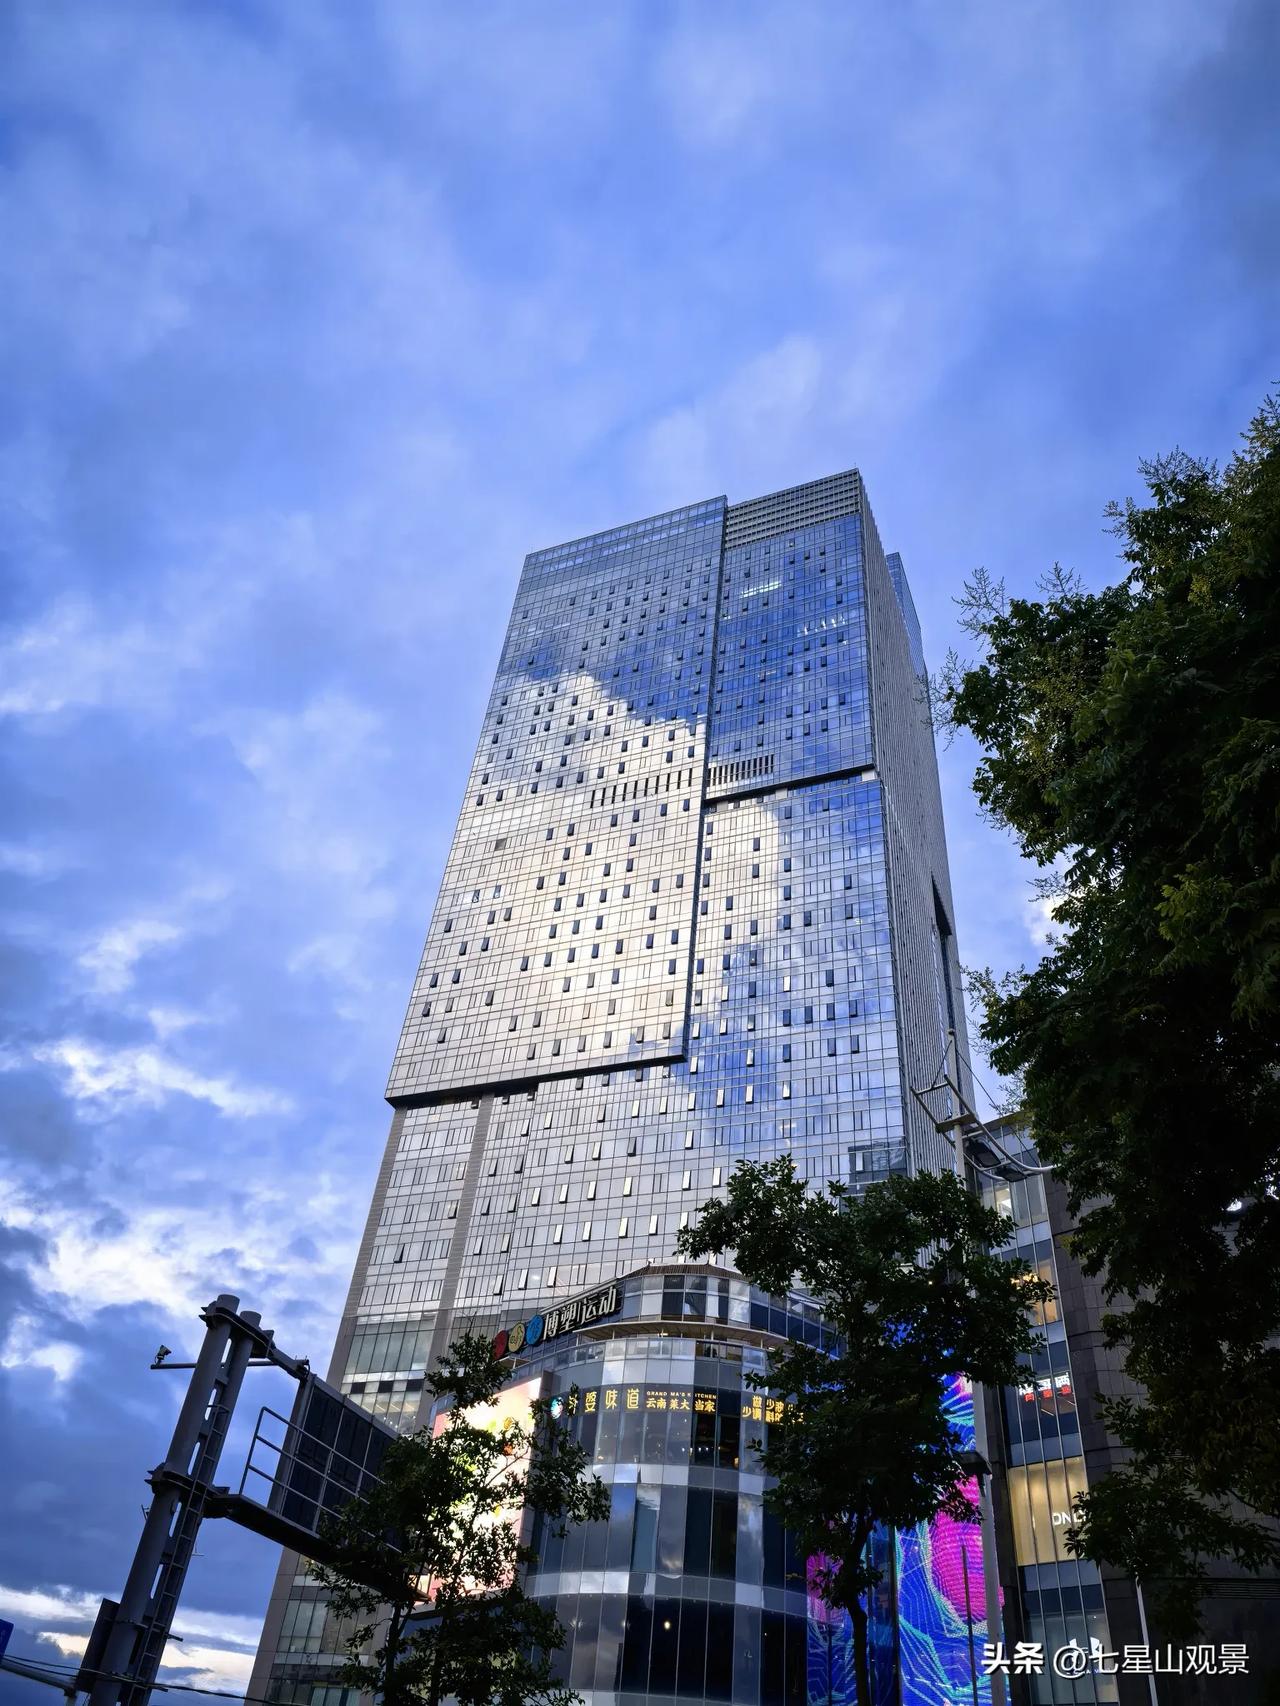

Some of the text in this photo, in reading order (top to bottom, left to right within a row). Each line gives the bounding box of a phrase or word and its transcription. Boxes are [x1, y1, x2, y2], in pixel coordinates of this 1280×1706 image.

[646, 1397, 716, 1412] 云南菜大当家
